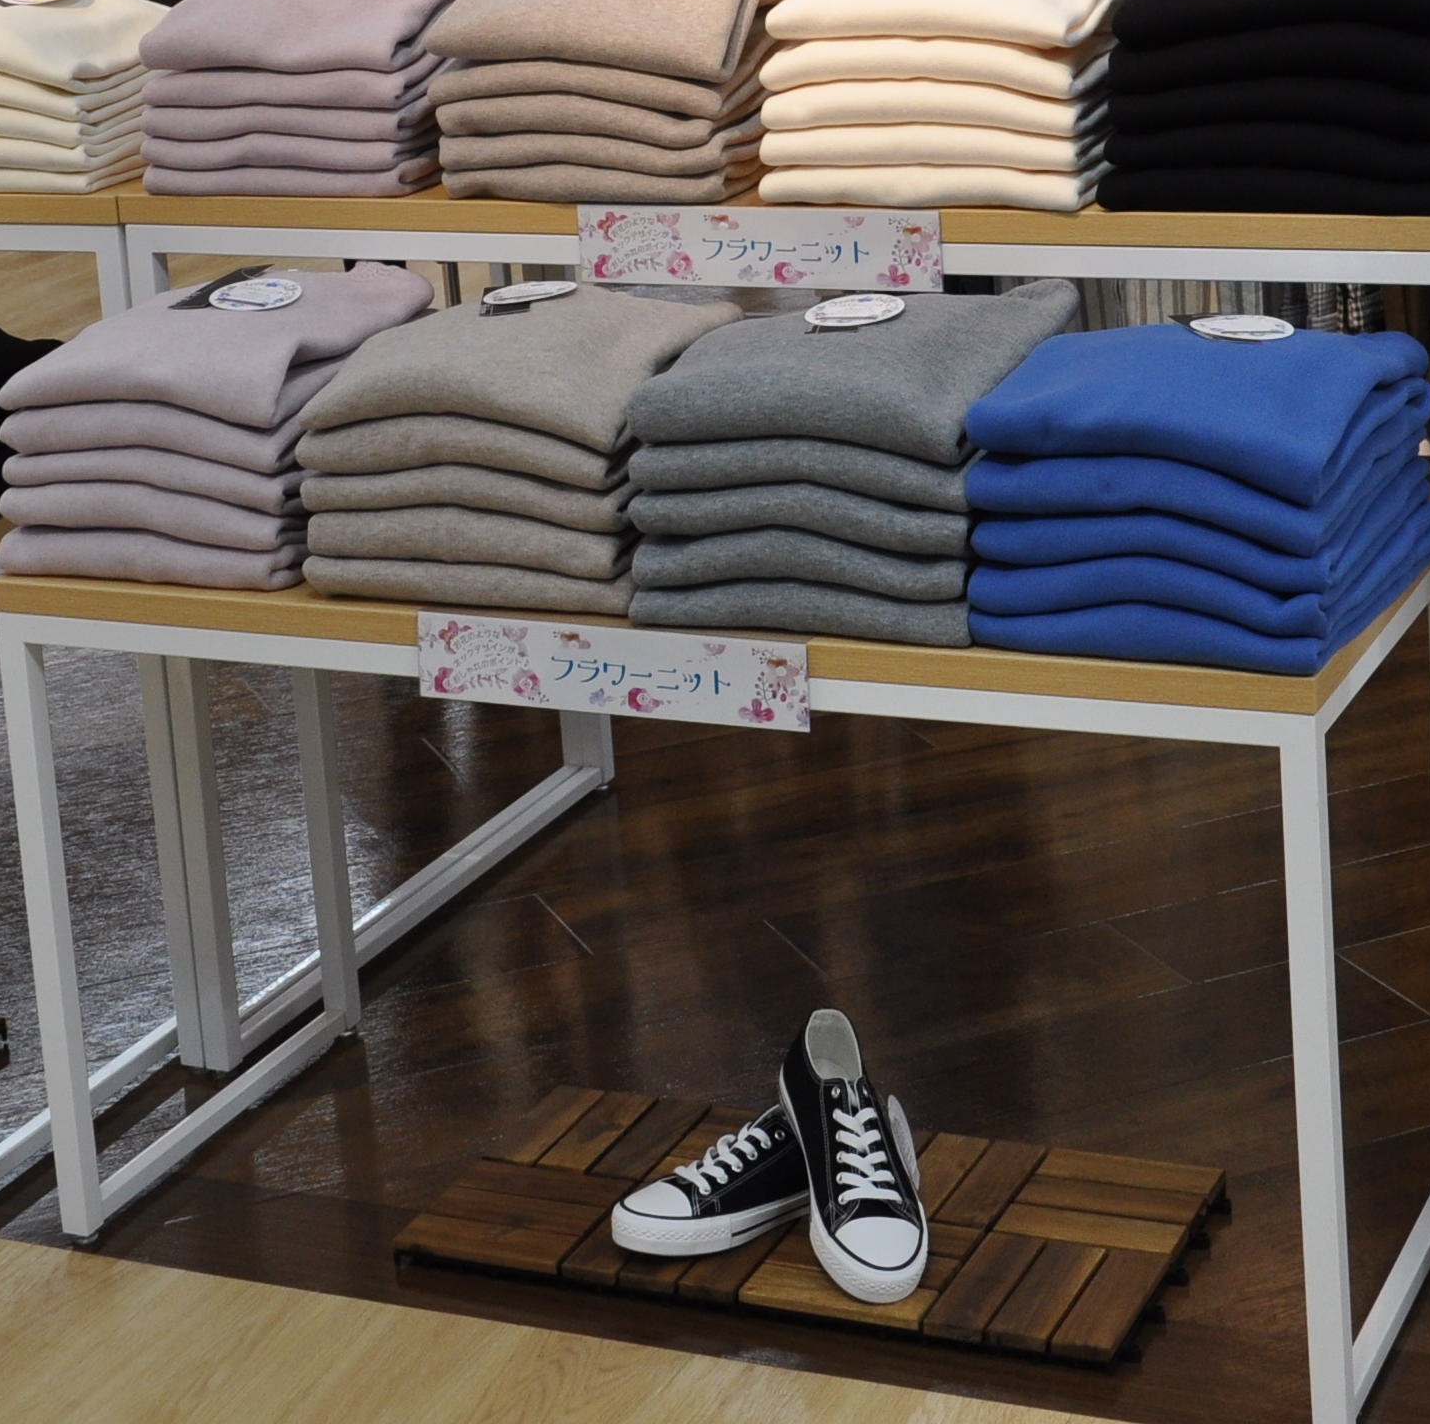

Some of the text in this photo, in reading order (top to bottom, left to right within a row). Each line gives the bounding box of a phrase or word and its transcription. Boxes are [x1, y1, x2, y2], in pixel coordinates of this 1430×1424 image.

[702, 237, 870, 263] フラワーニット
[551, 655, 731, 695] フラワーニット
